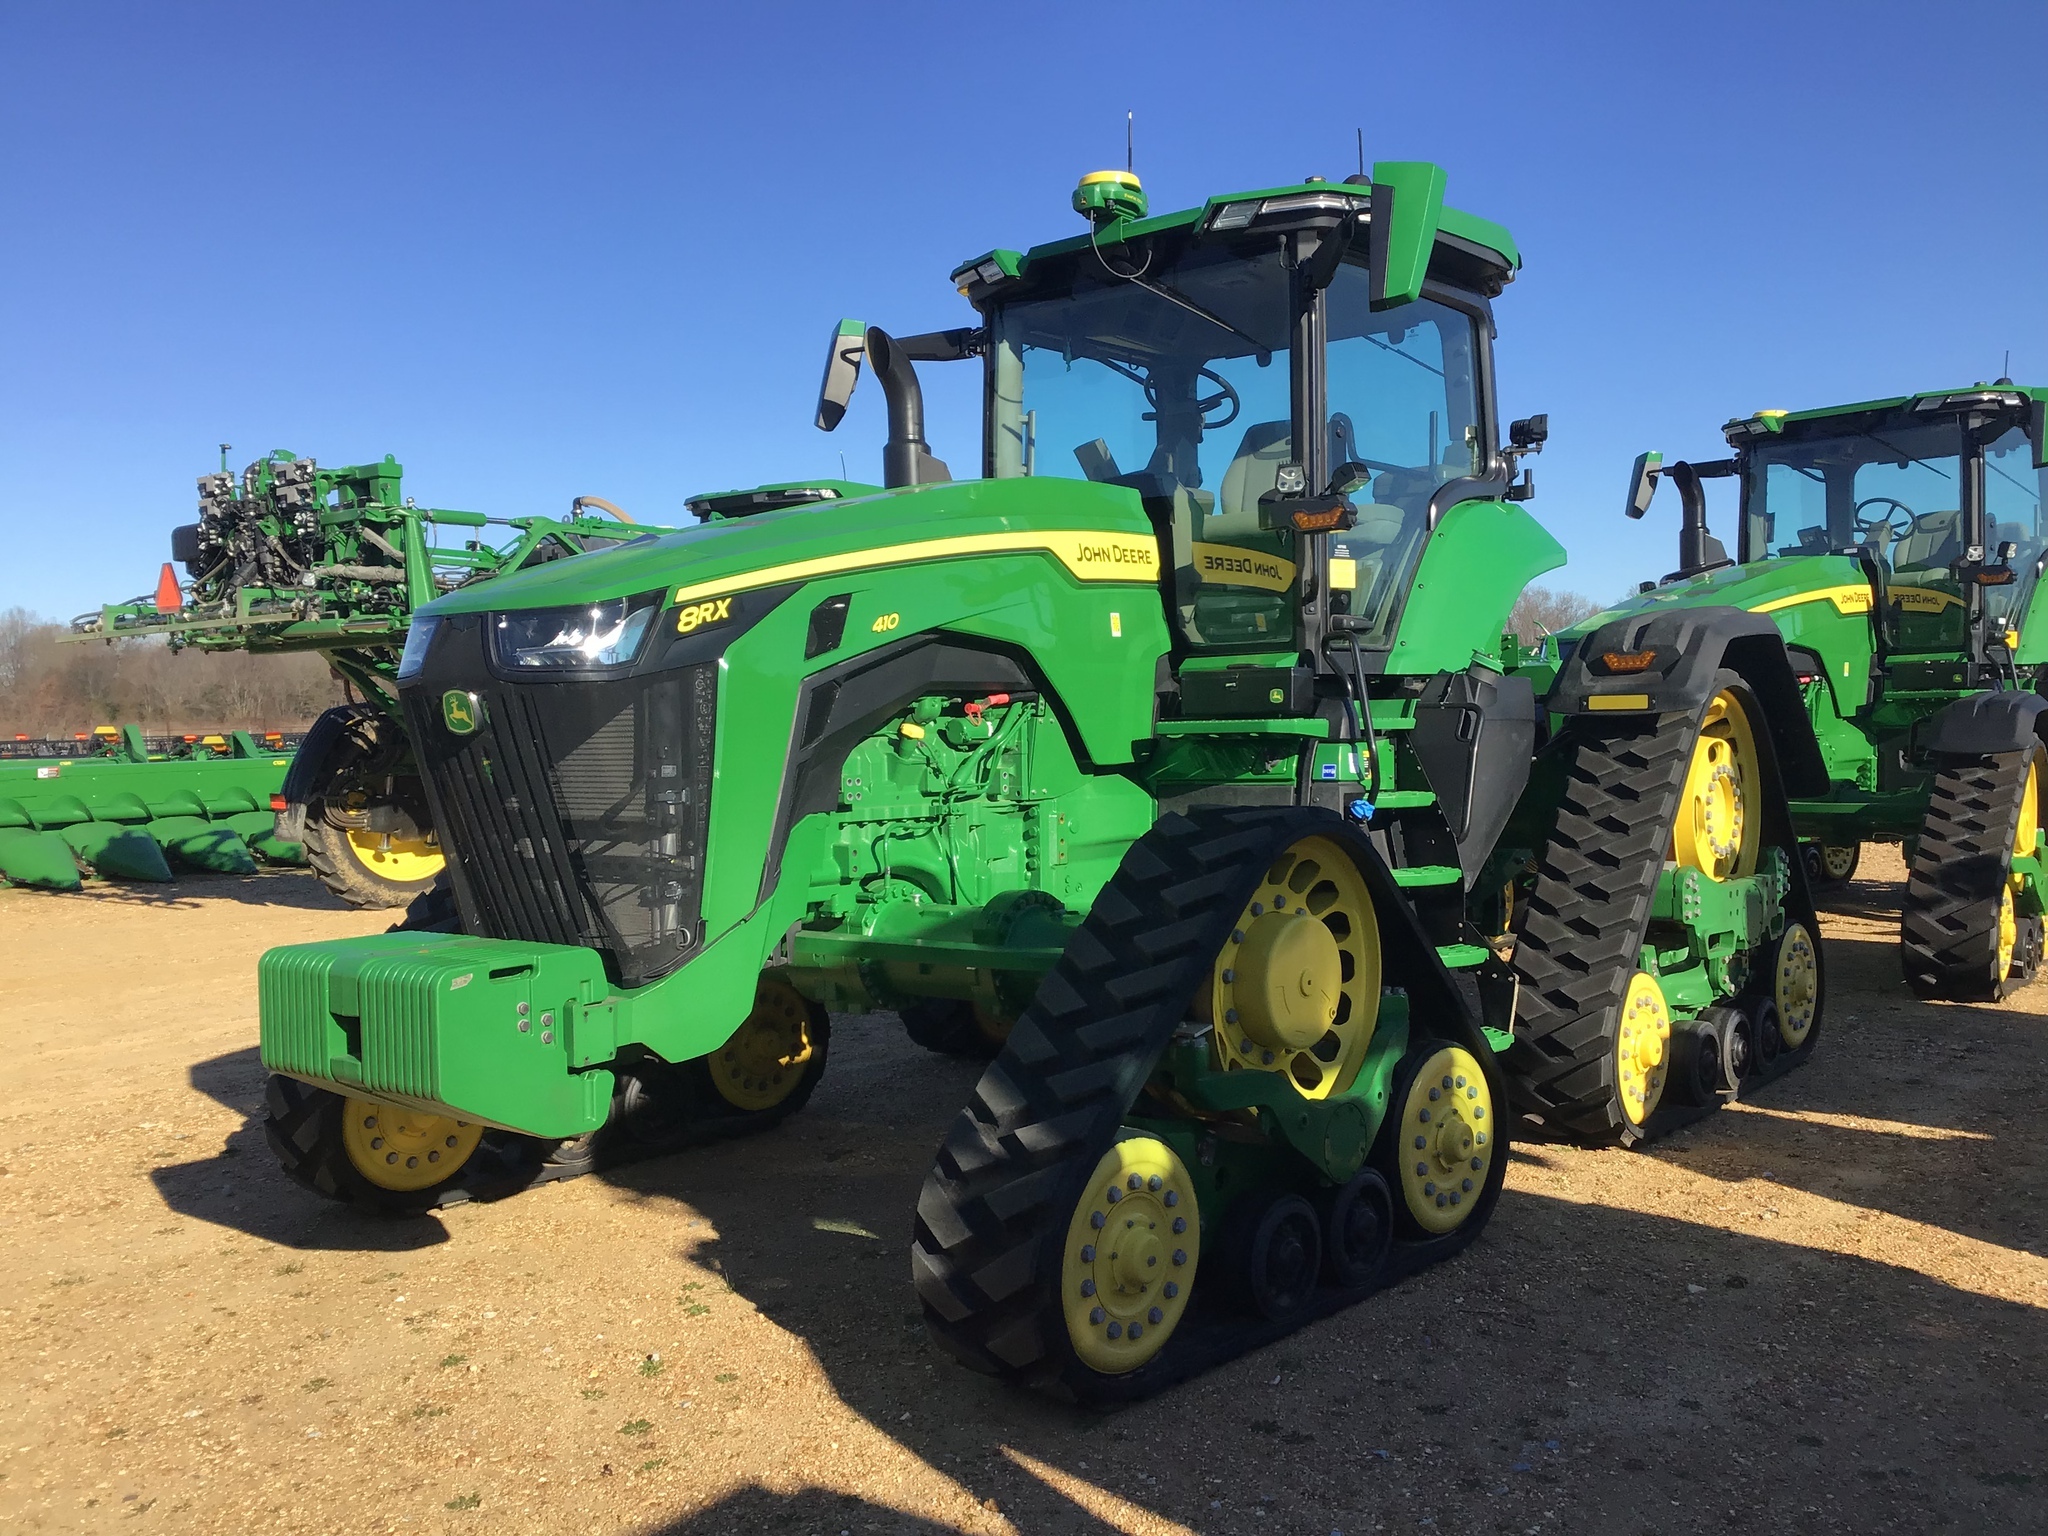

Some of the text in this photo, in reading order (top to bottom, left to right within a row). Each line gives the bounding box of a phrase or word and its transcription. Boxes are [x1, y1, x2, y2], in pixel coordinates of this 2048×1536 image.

[1077, 543, 1152, 565] JOHN DEERE
[1841, 593, 1855, 605] JOHN
[676, 597, 732, 633] 8RX
[871, 612, 900, 634] 410
